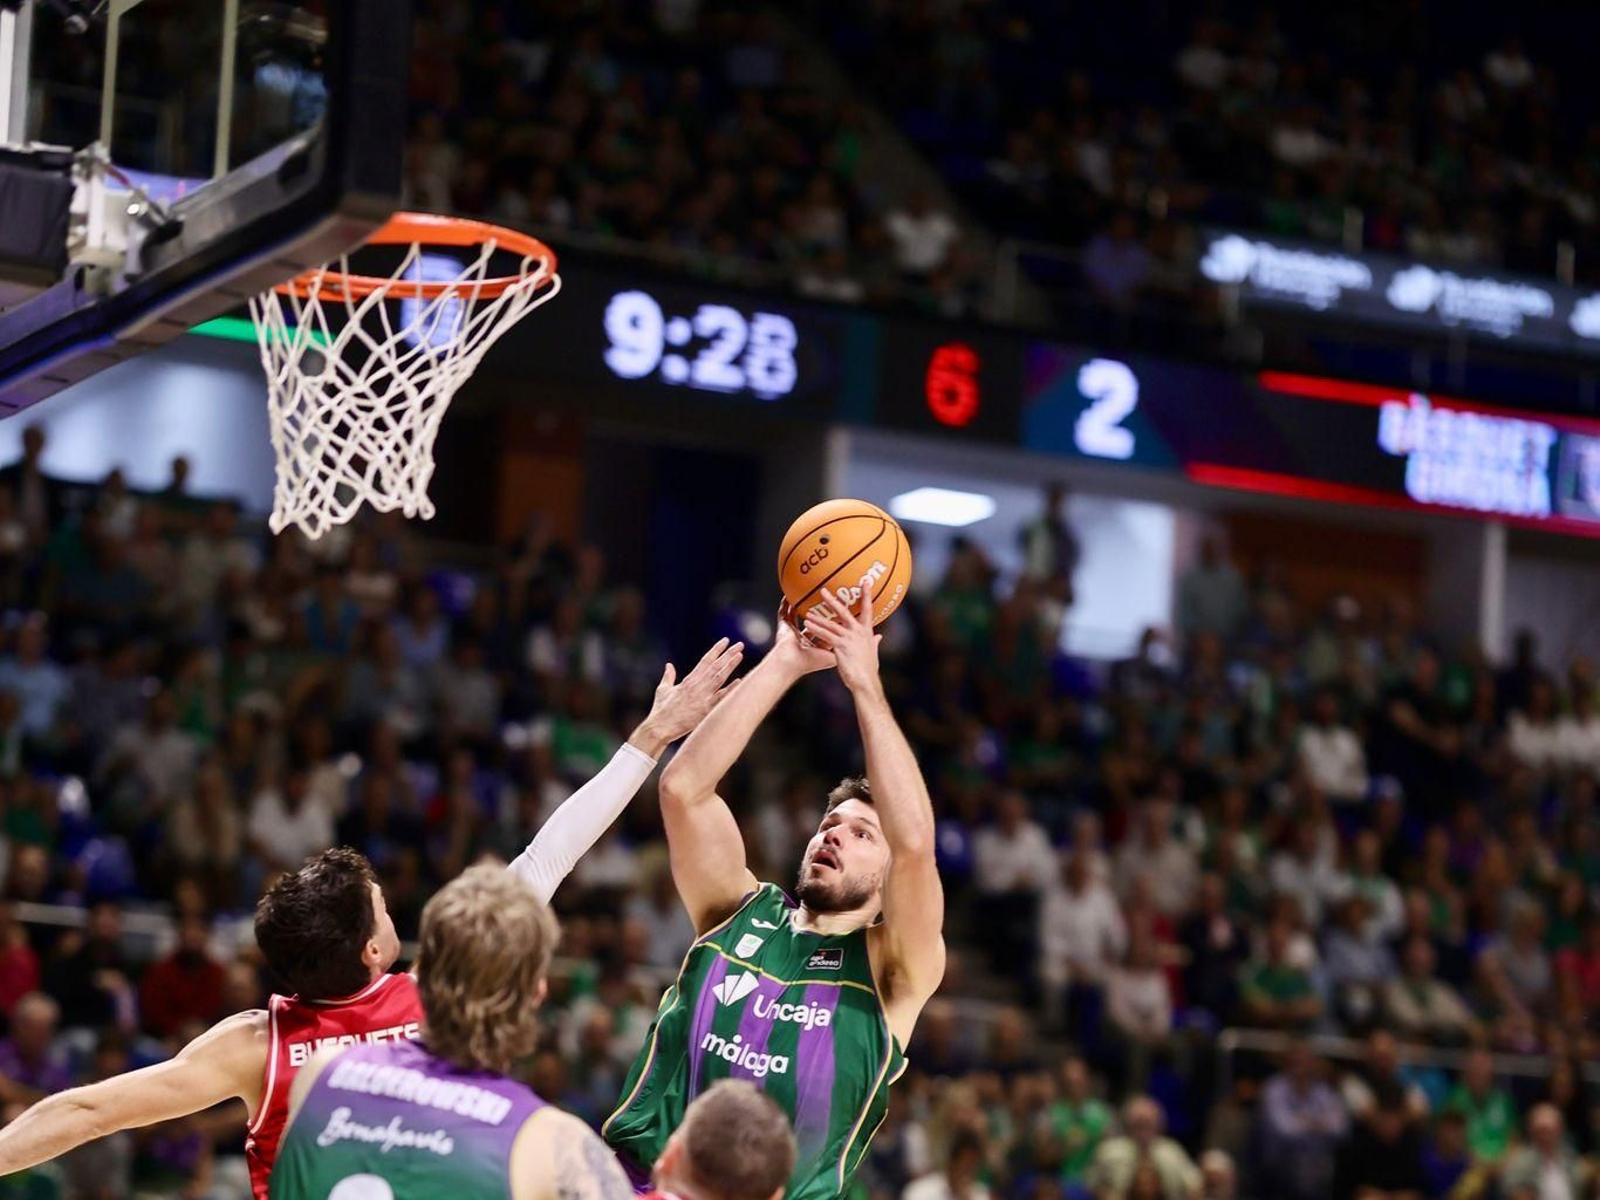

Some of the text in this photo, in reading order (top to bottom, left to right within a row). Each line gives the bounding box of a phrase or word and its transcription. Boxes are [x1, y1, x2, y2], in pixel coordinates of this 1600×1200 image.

[925, 342, 980, 428] 6
[1074, 358, 1139, 460] 2
[800, 546, 829, 575] acb
